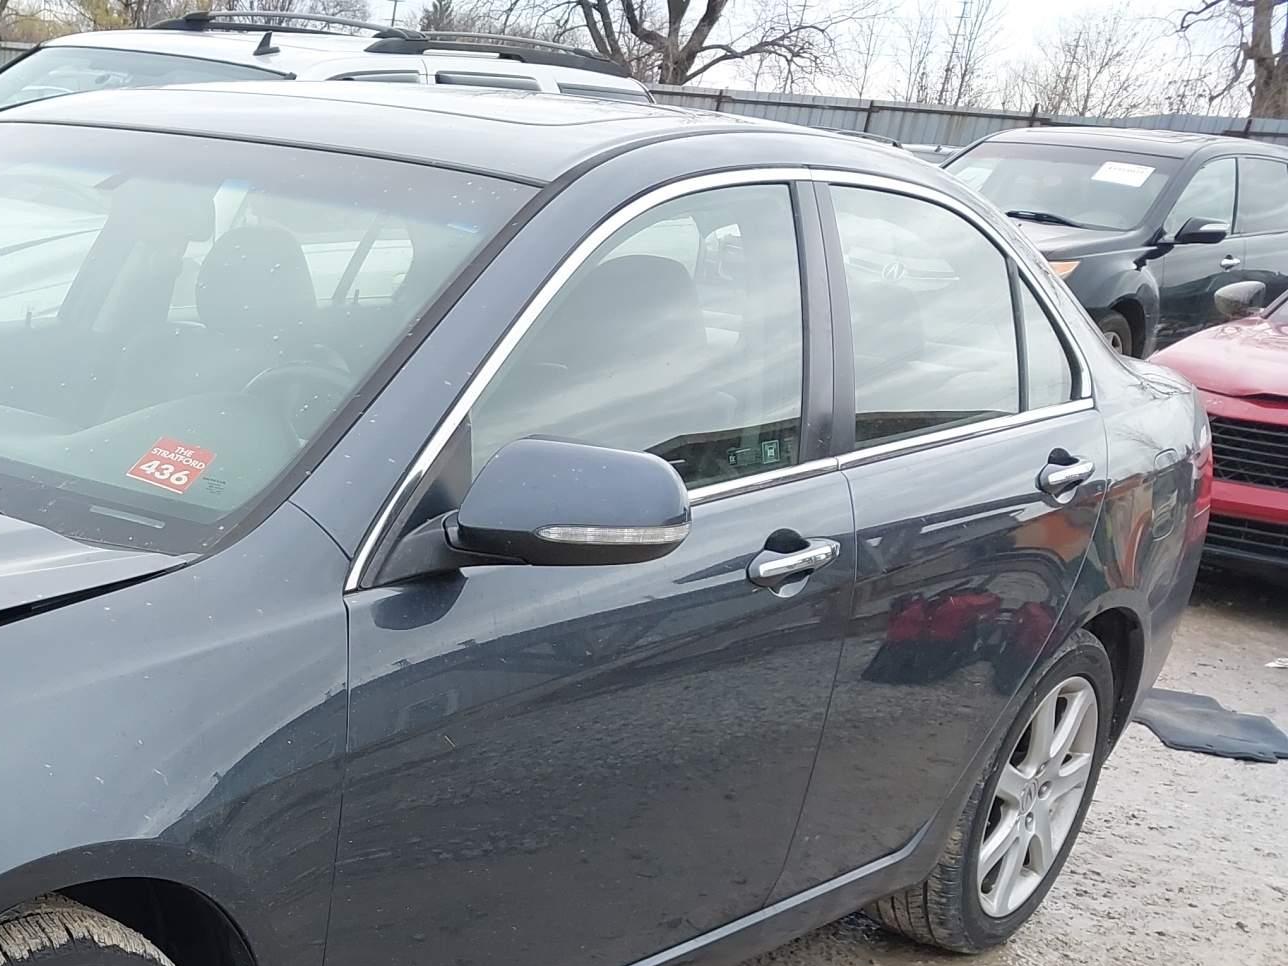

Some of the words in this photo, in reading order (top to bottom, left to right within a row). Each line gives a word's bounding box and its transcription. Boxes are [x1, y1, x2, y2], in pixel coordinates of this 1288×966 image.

[151, 447, 205, 470] STRATFORD
[175, 446, 194, 458] THE
[140, 460, 189, 485] 436
